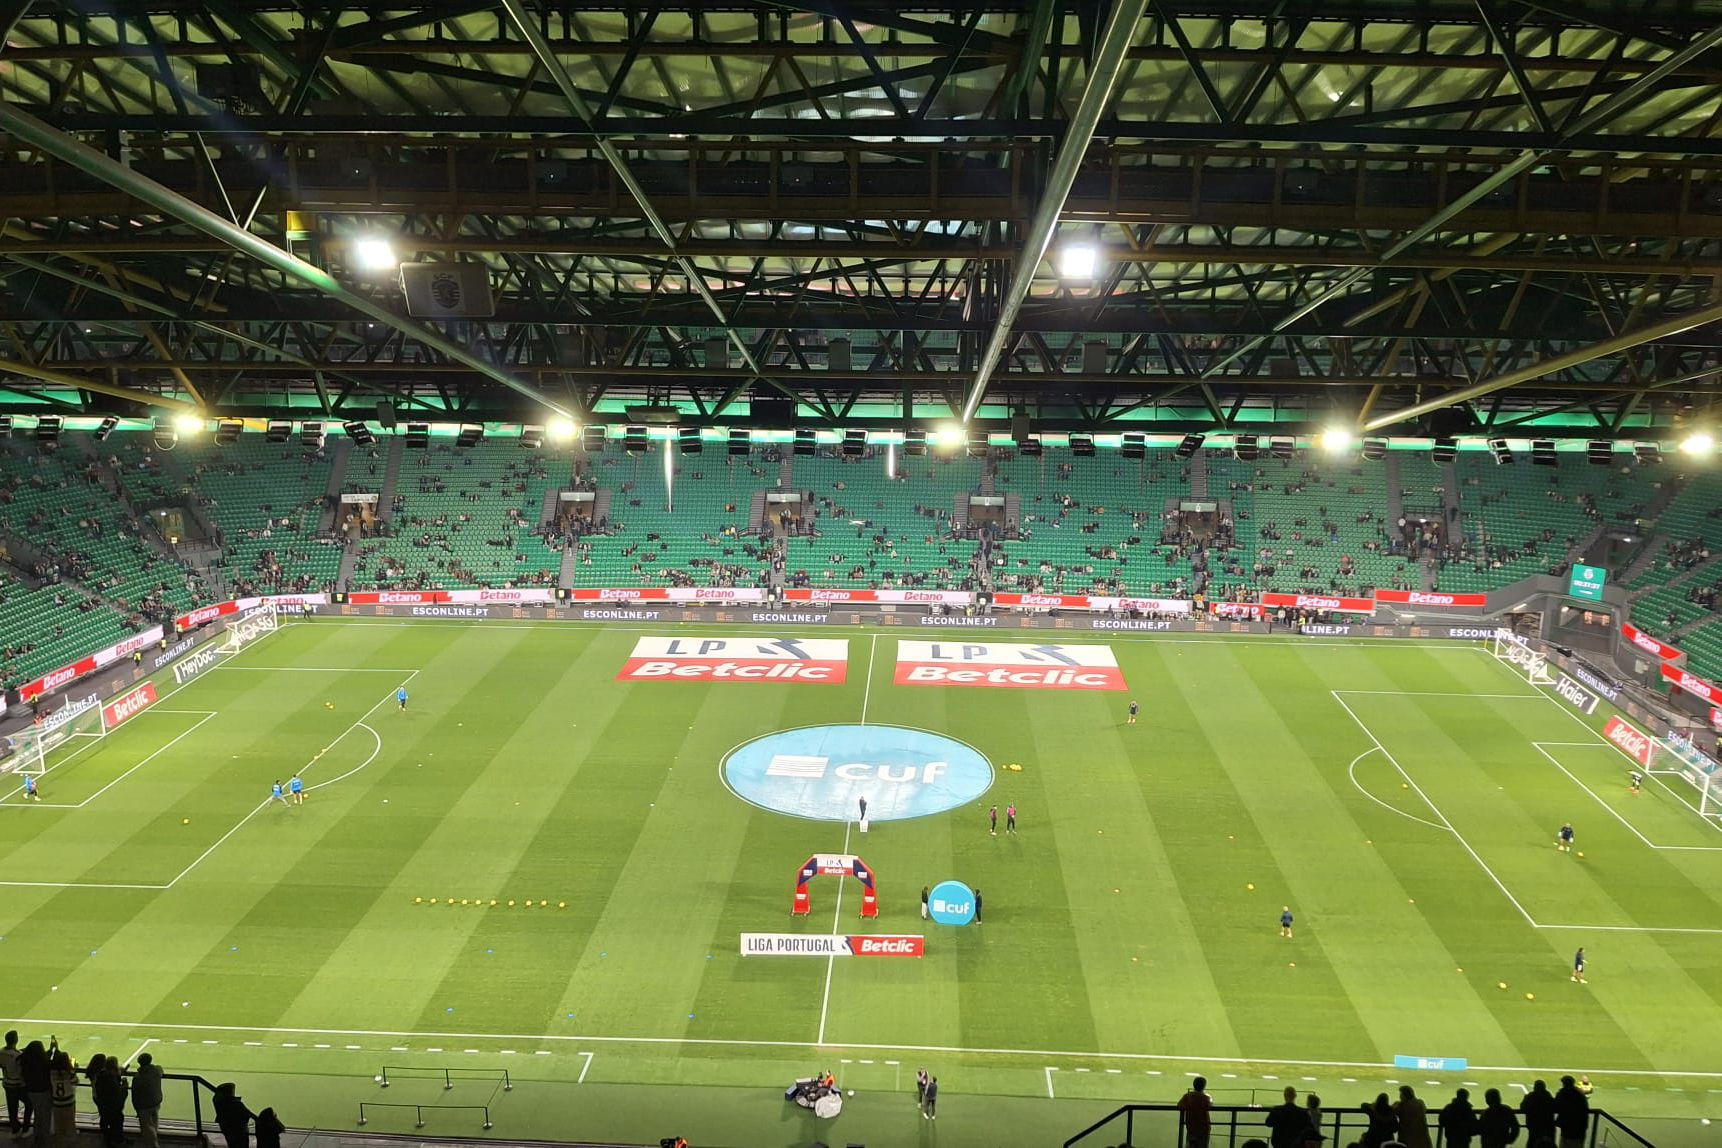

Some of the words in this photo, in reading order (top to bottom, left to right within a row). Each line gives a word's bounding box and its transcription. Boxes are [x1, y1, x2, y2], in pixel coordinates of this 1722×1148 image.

[379, 592, 422, 603] Betano
[480, 591, 522, 601] Betano
[600, 589, 640, 599] Betano
[696, 589, 735, 599] Betano
[811, 590, 850, 600] Betano
[904, 591, 943, 601] Betano
[1021, 594, 1062, 605] Betano
[1408, 592, 1454, 604] Betano
[1296, 596, 1340, 608] Betano
[188, 607, 220, 625] Betano
[412, 606, 489, 617] ESCONLINE.PT
[583, 610, 659, 620] ESCONLINE.PT
[752, 613, 828, 623] ESCONLINE.PT
[921, 616, 998, 626] ESCONLINE.PT
[1092, 619, 1171, 630] ESCONLINE.PT
[116, 637, 144, 656] Betano
[154, 637, 194, 668] ESCONLINE.PT
[666, 639, 727, 655] LP
[931, 644, 989, 660] LP
[630, 661, 833, 680] Betclic
[907, 666, 1109, 686] Betclic
[43, 667, 76, 690] Betano
[1556, 678, 1588, 707] Haier
[113, 690, 149, 721] Betclic
[1609, 723, 1646, 757] Betclic
[834, 761, 948, 784] cuf
[947, 902, 970, 914] cuf
[748, 938, 773, 951] LIGA
[777, 939, 836, 952] PORTUGAL
[861, 940, 915, 953] Betclic
